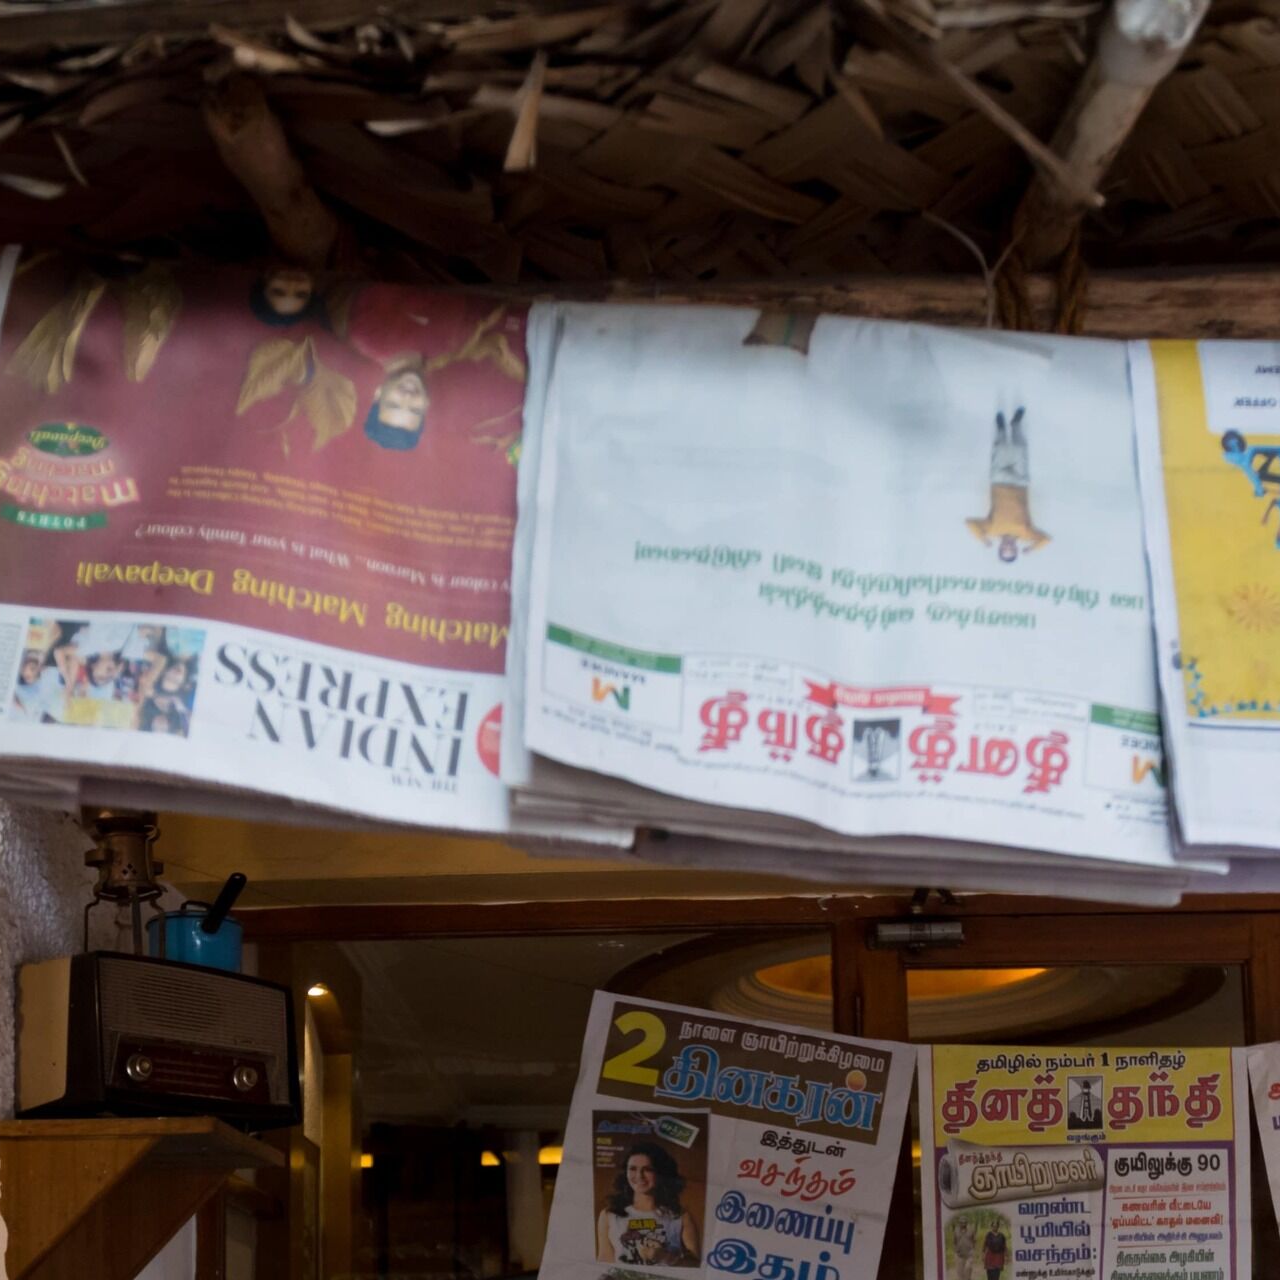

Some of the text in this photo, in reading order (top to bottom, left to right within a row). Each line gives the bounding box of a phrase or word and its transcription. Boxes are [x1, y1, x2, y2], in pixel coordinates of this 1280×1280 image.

[135, 523, 193, 538] colour?
[198, 524, 245, 547] family
[253, 530, 286, 552] your
[292, 543, 303, 561] is
[310, 545, 350, 568] What
[76, 560, 367, 626] Matching Deepavali
[431, 574, 445, 590] is
[450, 575, 496, 592] colour
[214, 643, 468, 731] EXPRESS
[246, 700, 462, 777] INDIAN
[602, 1011, 666, 1086] 2
[679, 1020, 885, 1073] நாளை ஞாயிற்றுக்கிழமை
[976, 1051, 1186, 1074] தமிழில் நம்பர் 1 நாளிதழ்
[654, 1044, 882, 1130] தினகரன்
[942, 1071, 1221, 1133] தினத் தந்தி
[760, 1130, 846, 1158] இத்துடன்
[1066, 1132, 1106, 1143] வழங்கும்
[1114, 1152, 1220, 1180] குயிலுக்கு 90
[737, 1157, 856, 1201] வசந்தம்
[1019, 1198, 1091, 1219] வறண்ட
[1122, 1199, 1211, 1212] கணவரின் வீட்டையே
[716, 1190, 855, 1254] இணைப்பு
[1156, 1213, 1223, 1228] காதல் மனைவி!
[1020, 1221, 1090, 1244] பூமியில்
[1015, 1243, 1097, 1265] வசந்தம்:
[1116, 1249, 1214, 1267] திருநங்கை அழகியின்
